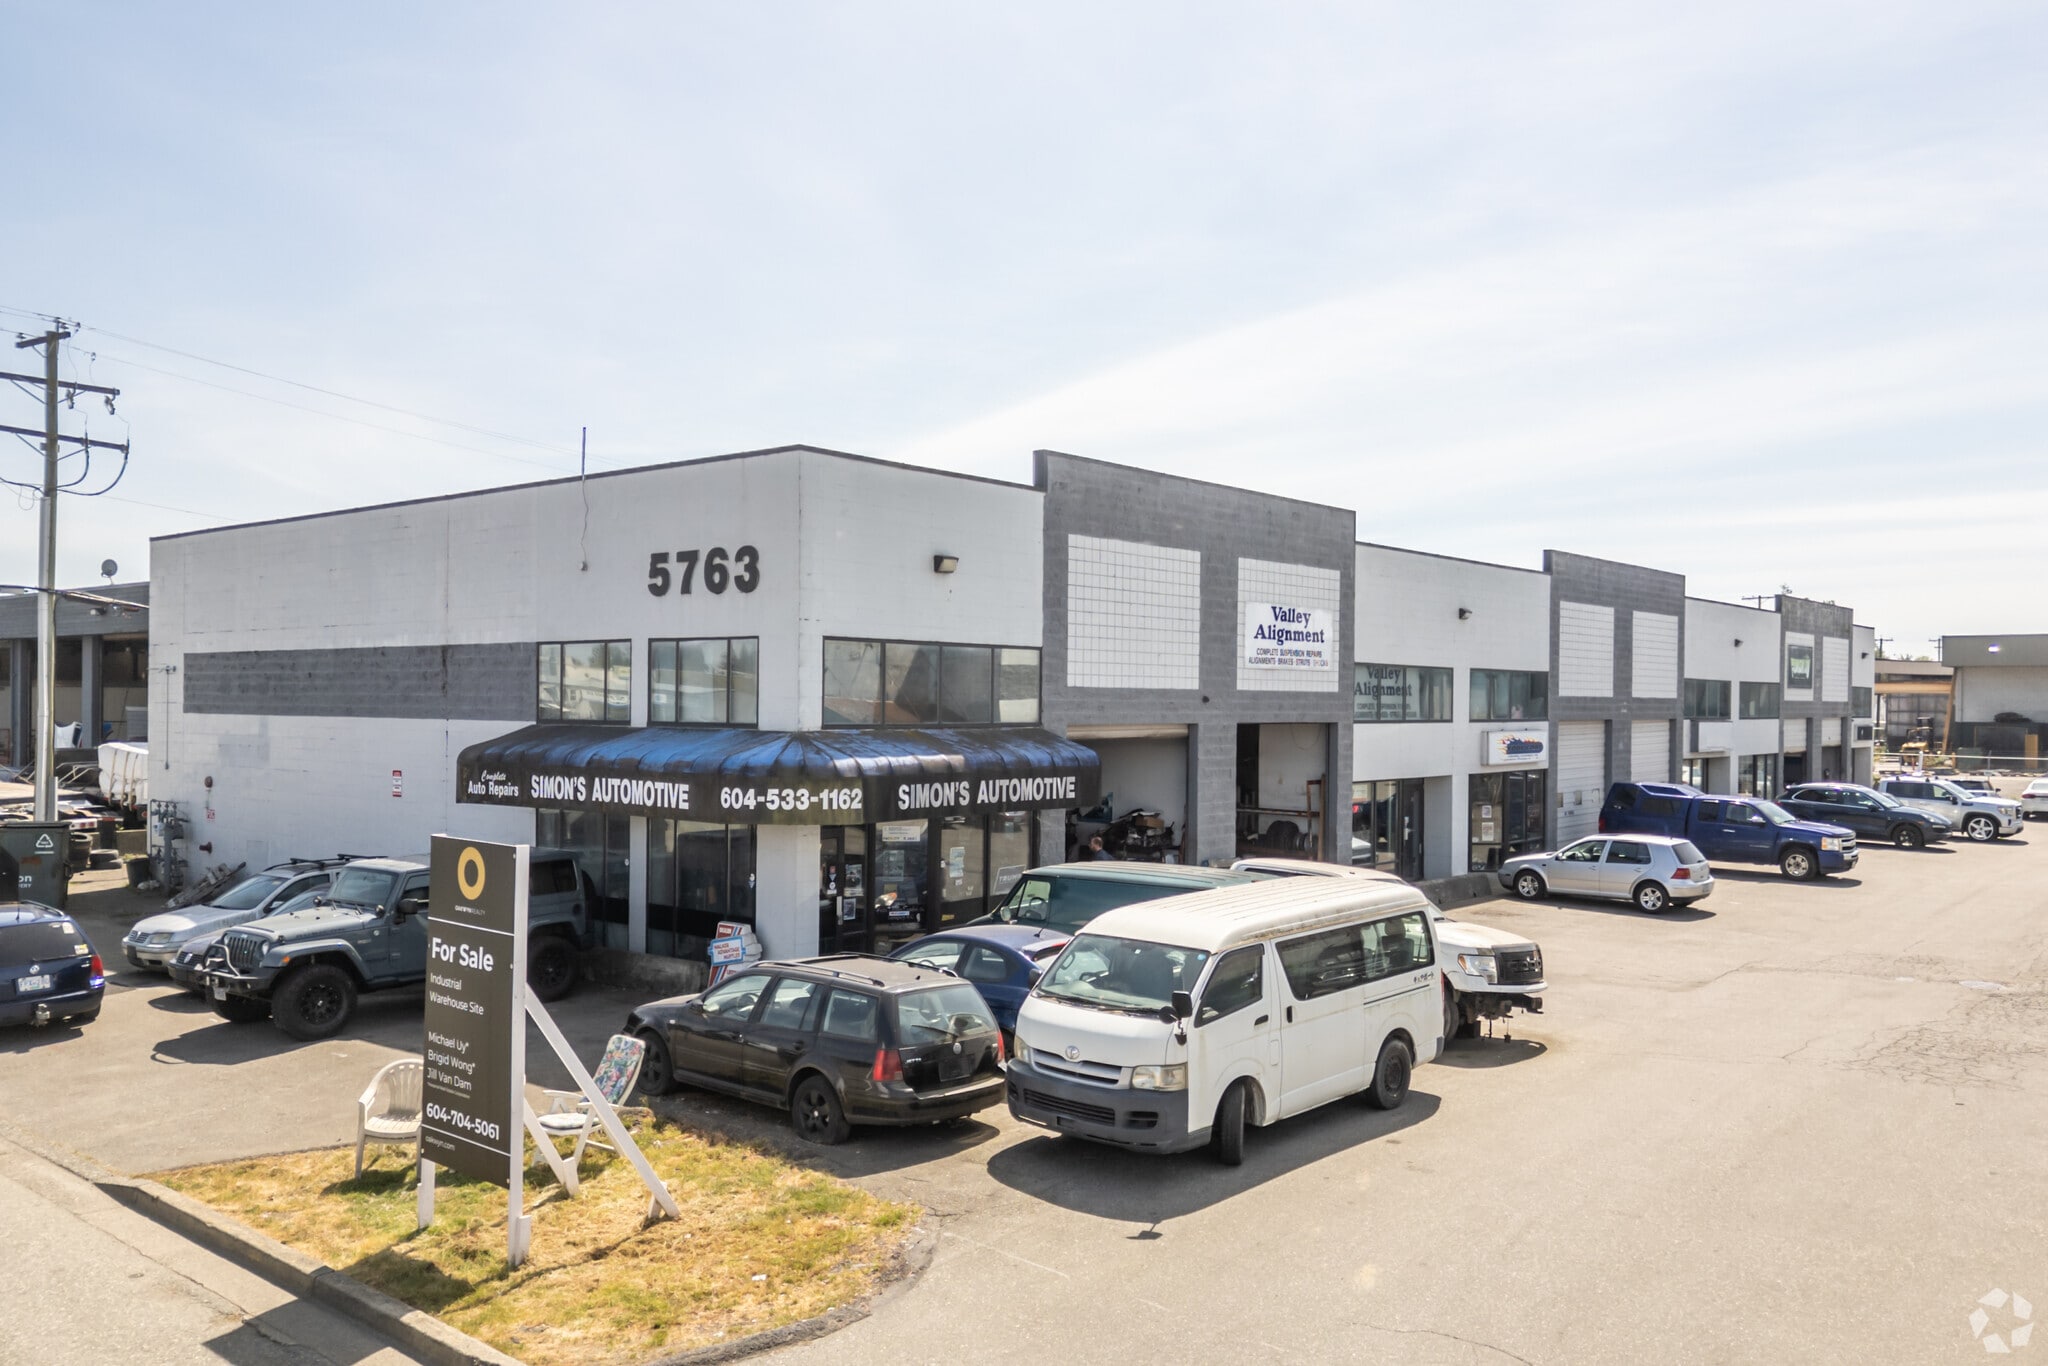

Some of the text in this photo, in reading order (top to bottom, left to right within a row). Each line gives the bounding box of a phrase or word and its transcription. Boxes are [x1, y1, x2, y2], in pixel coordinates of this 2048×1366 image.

[648, 545, 760, 597] 5763
[1271, 606, 1311, 628] Valley
[1253, 624, 1325, 645] Alignment
[1256, 648, 1278, 656] COMPLETE
[1367, 665, 1401, 684] Valley
[481, 769, 507, 782] Complete
[468, 780, 519, 798] Auto Repairs
[531, 775, 689, 810] SIMON'S AUTOMOTIVE
[720, 787, 862, 811] 604-533-1162
[898, 776, 1076, 810] SIMON'S AUTOMOTIVE
[432, 937, 494, 972] For Sale
[430, 972, 462, 990] Industrial
[429, 990, 484, 1015] Warehouse Site
[428, 1031, 456, 1048] Michael
[428, 1049, 450, 1065] Brigid
[427, 1067, 437, 1080] Jill
[438, 1070, 453, 1085] Van
[453, 1075, 472, 1091] Dam
[426, 1103, 500, 1140] 604-704-5061
